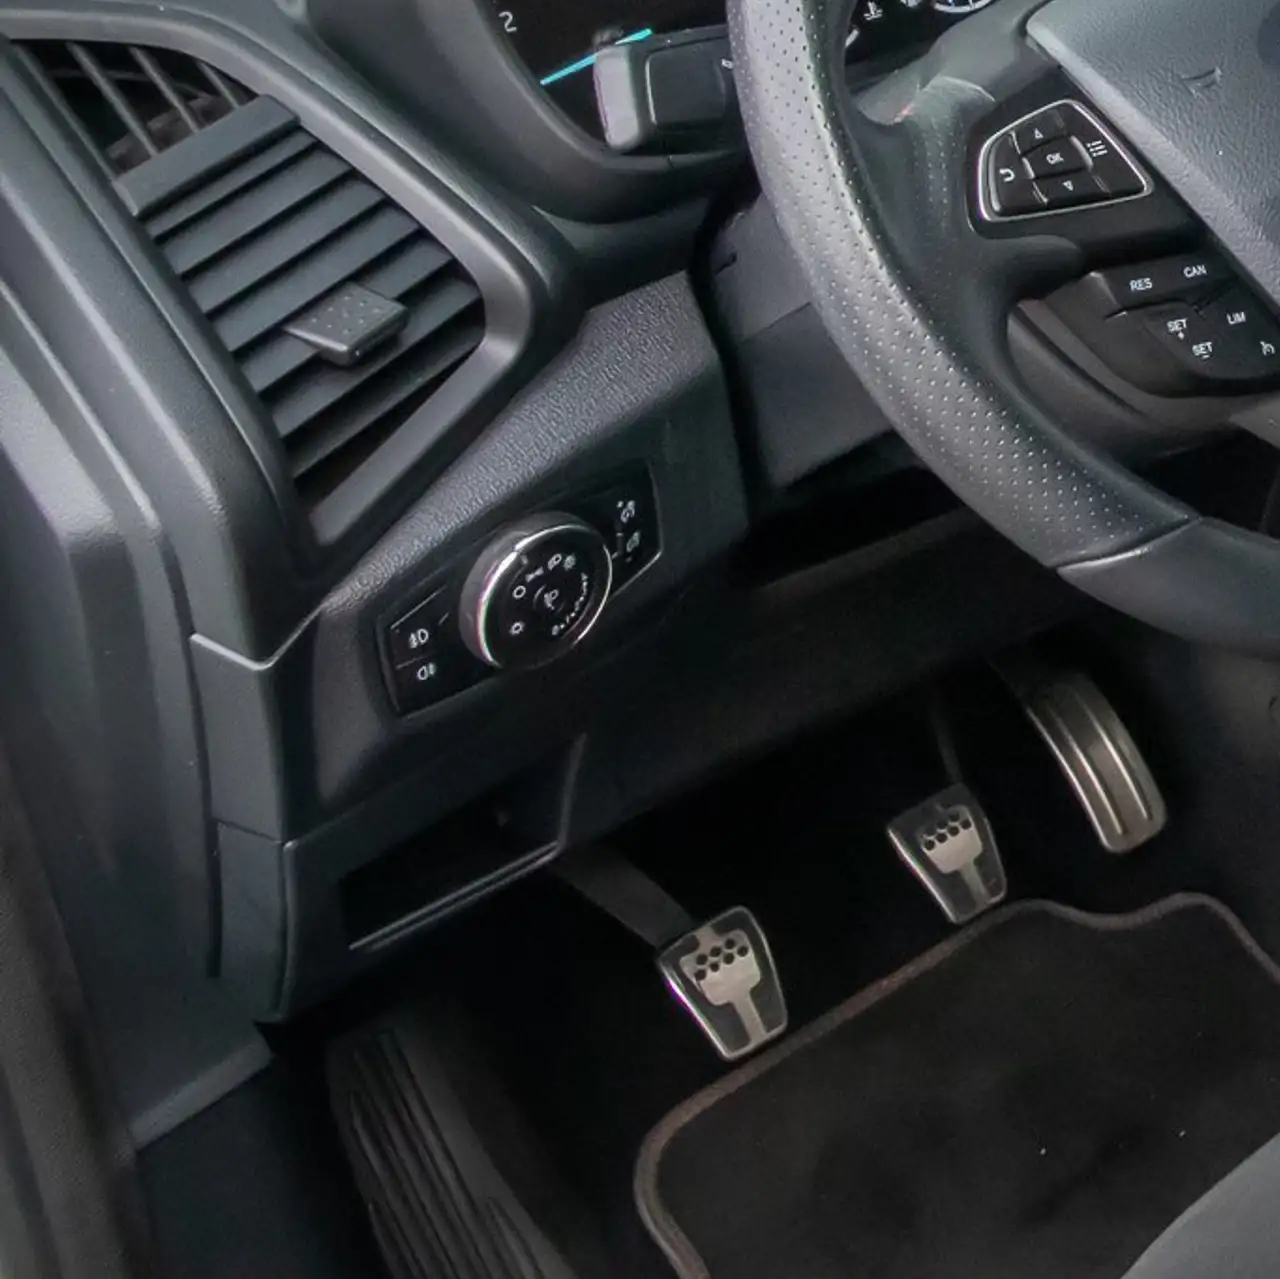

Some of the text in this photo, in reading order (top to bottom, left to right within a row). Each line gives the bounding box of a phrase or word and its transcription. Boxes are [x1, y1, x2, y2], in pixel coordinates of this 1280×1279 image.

[498, 11, 517, 33] 2
[1046, 151, 1065, 165] OK
[1130, 264, 1207, 292] RES CAN
[1166, 317, 1188, 333] SET
[1226, 311, 1247, 325] LIM
[1192, 341, 1213, 357] SET
